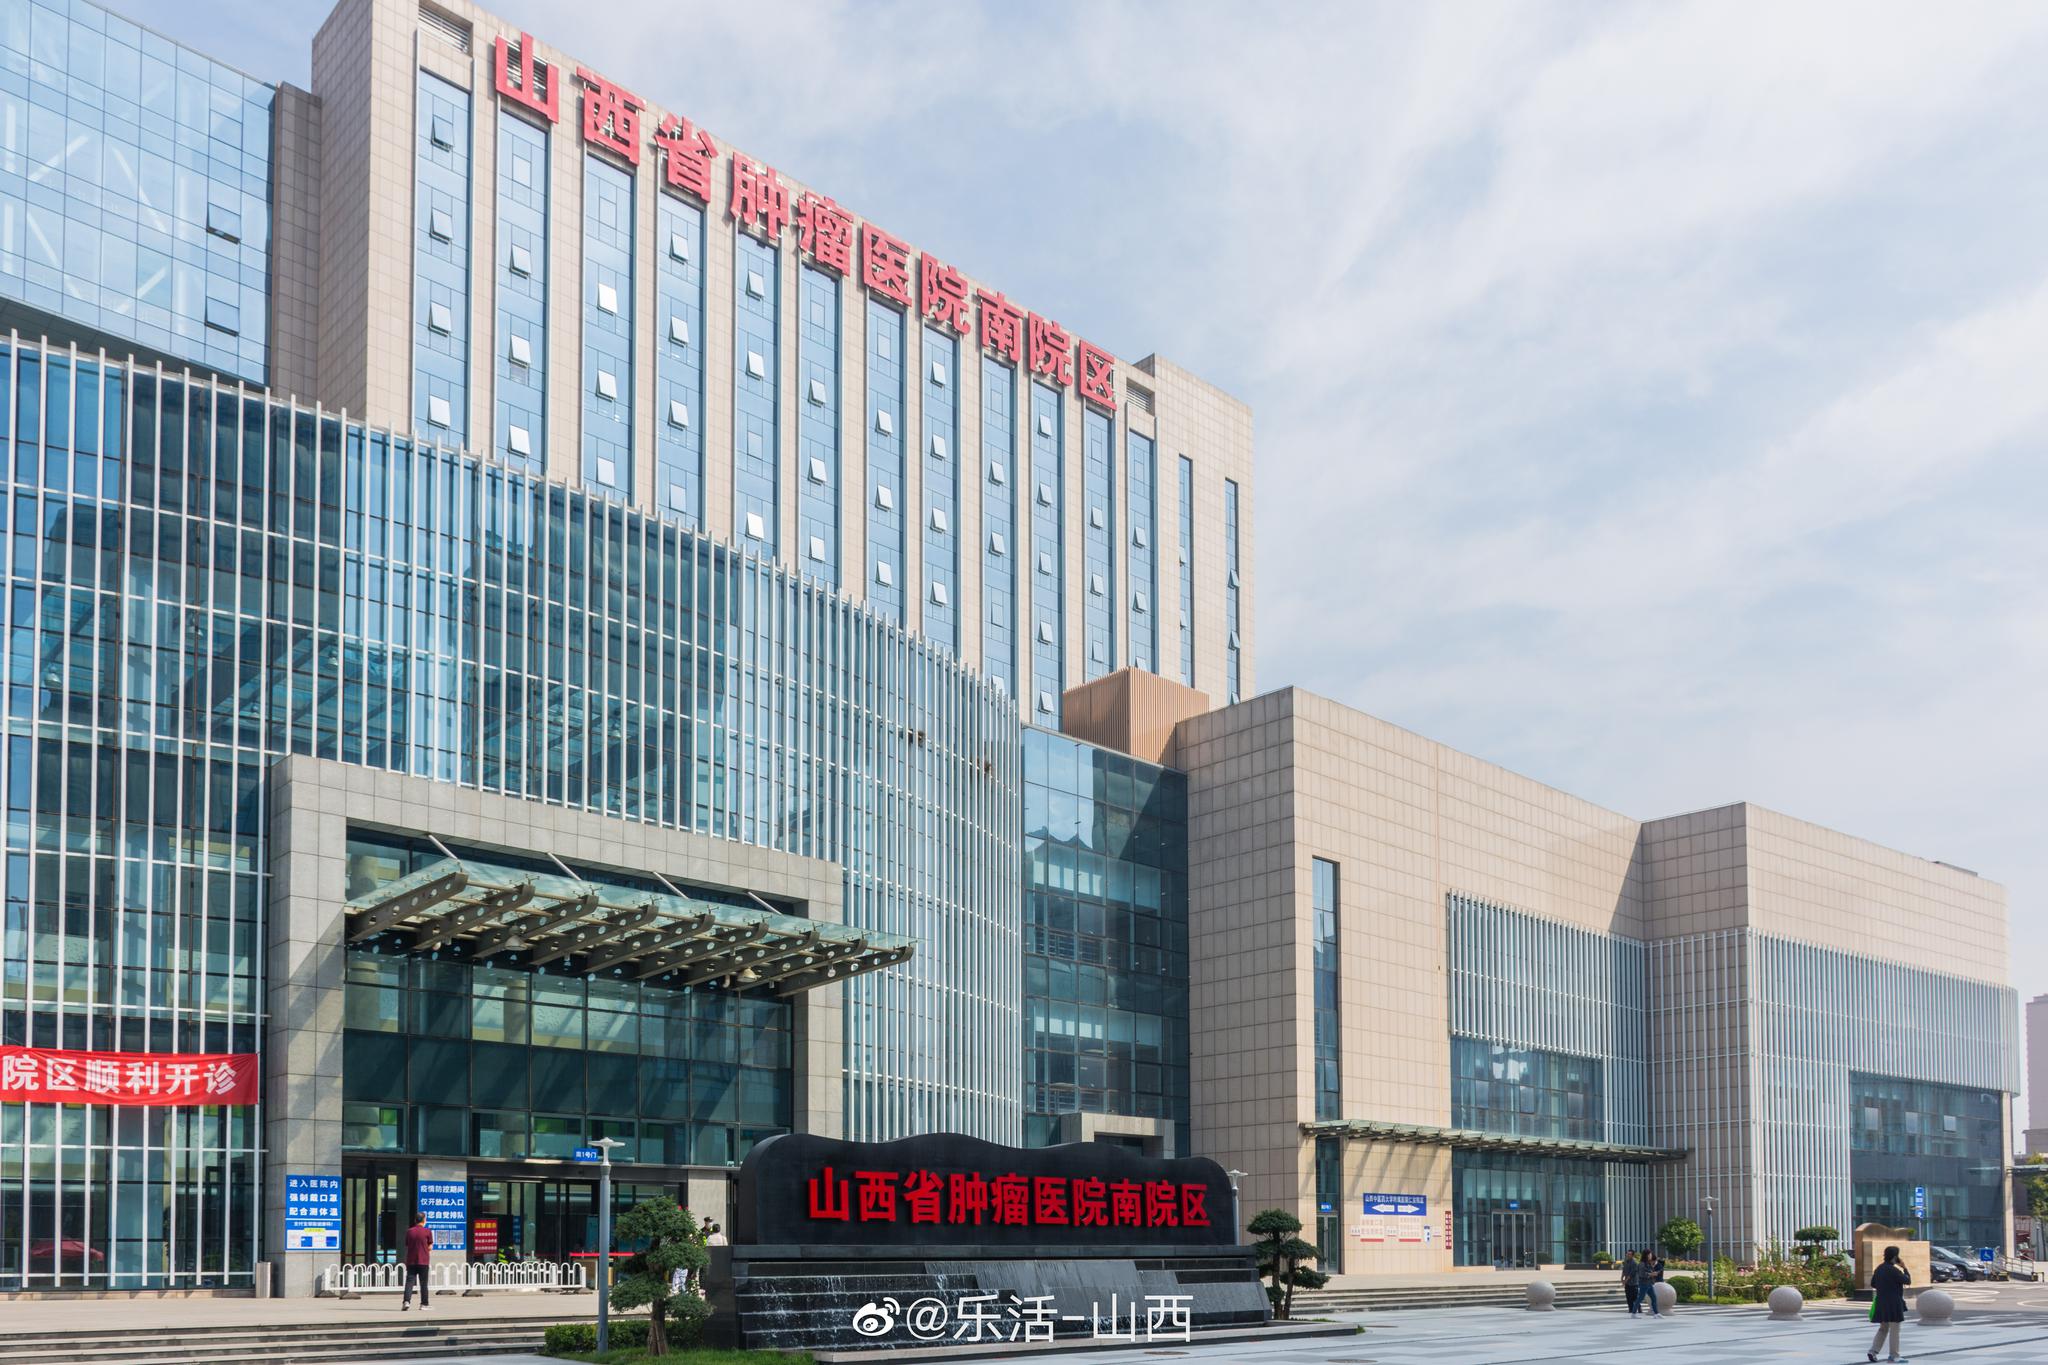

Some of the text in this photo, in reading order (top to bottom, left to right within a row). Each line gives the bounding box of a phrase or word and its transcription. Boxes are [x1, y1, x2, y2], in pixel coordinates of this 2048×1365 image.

[495, 31, 1117, 411] 山西省肿瘤医院南院区
[2, 1054, 237, 1095] 院区顺利开诊
[289, 1179, 338, 1189] 进入医院内
[420, 1185, 465, 1194] 疫情防控期间
[289, 1193, 338, 1202] 强制戴口罩
[420, 1197, 465, 1206] 仅开放此入口
[808, 1166, 1211, 1228] 山西省肿瘤医院南院区
[289, 1207, 338, 1216] 配合测体温
